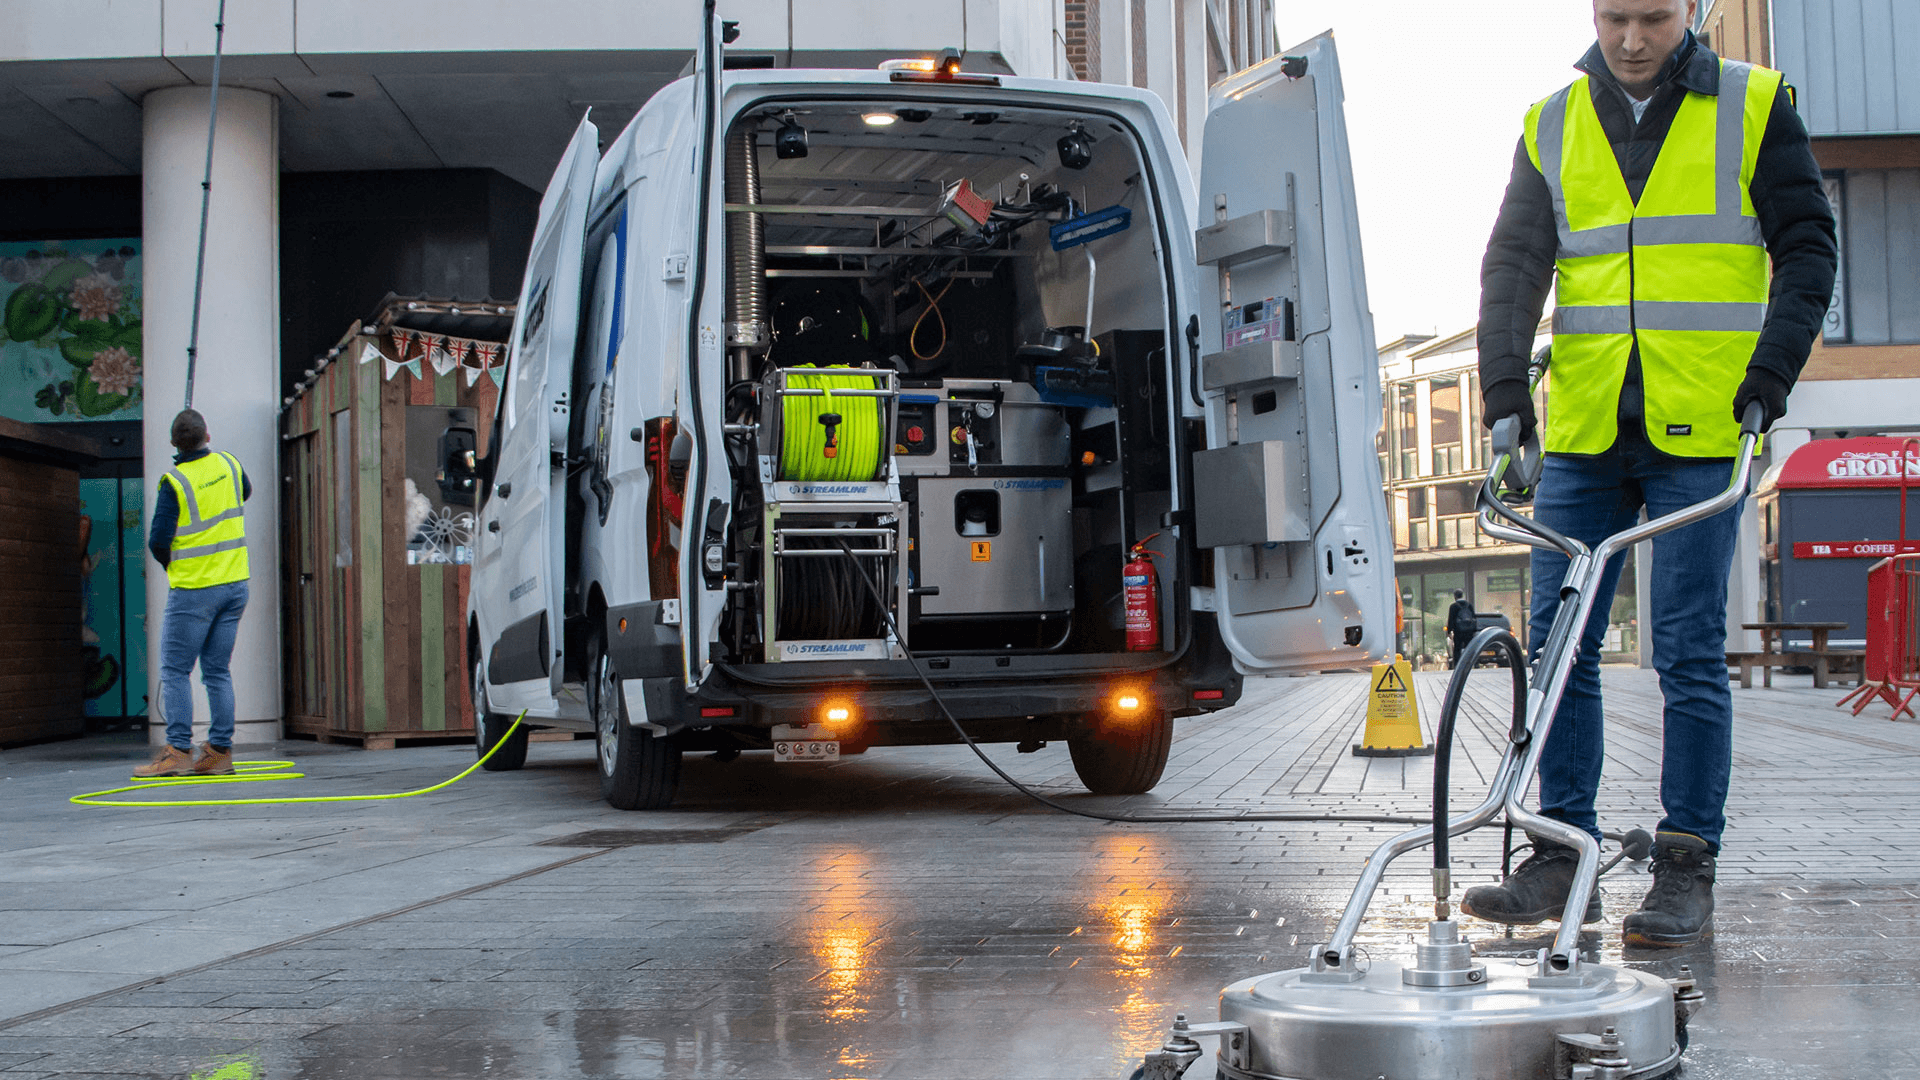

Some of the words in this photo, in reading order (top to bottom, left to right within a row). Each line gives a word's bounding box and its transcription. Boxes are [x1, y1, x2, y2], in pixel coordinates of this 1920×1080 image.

[802, 485, 868, 494] STREAMLINE
[1812, 545, 1831, 554] TEA
[1853, 544, 1895, 553] COFFEE
[800, 644, 866, 653] STREAMLINE
